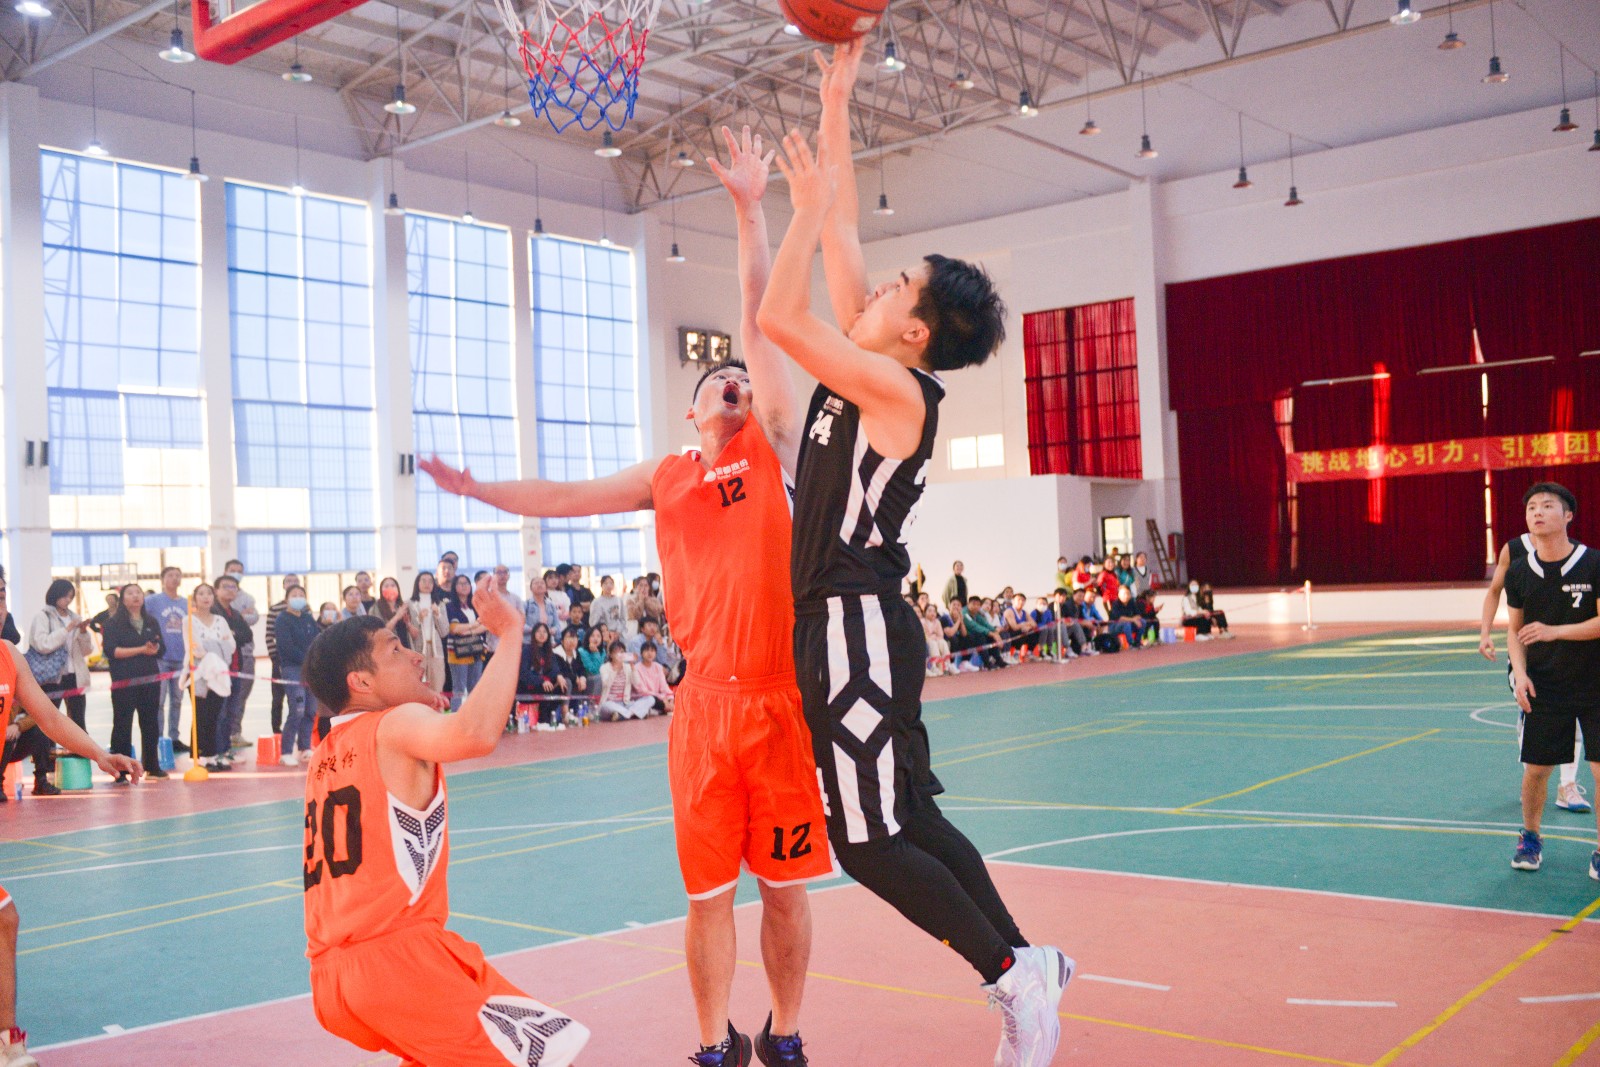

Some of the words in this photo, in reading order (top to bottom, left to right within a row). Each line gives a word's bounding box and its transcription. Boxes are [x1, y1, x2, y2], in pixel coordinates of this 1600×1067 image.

[1302, 431, 1600, 474] 挑战地心引力，引爆团
[717, 477, 747, 507] 12
[1572, 592, 1583, 608] 7
[771, 822, 812, 860] 12
